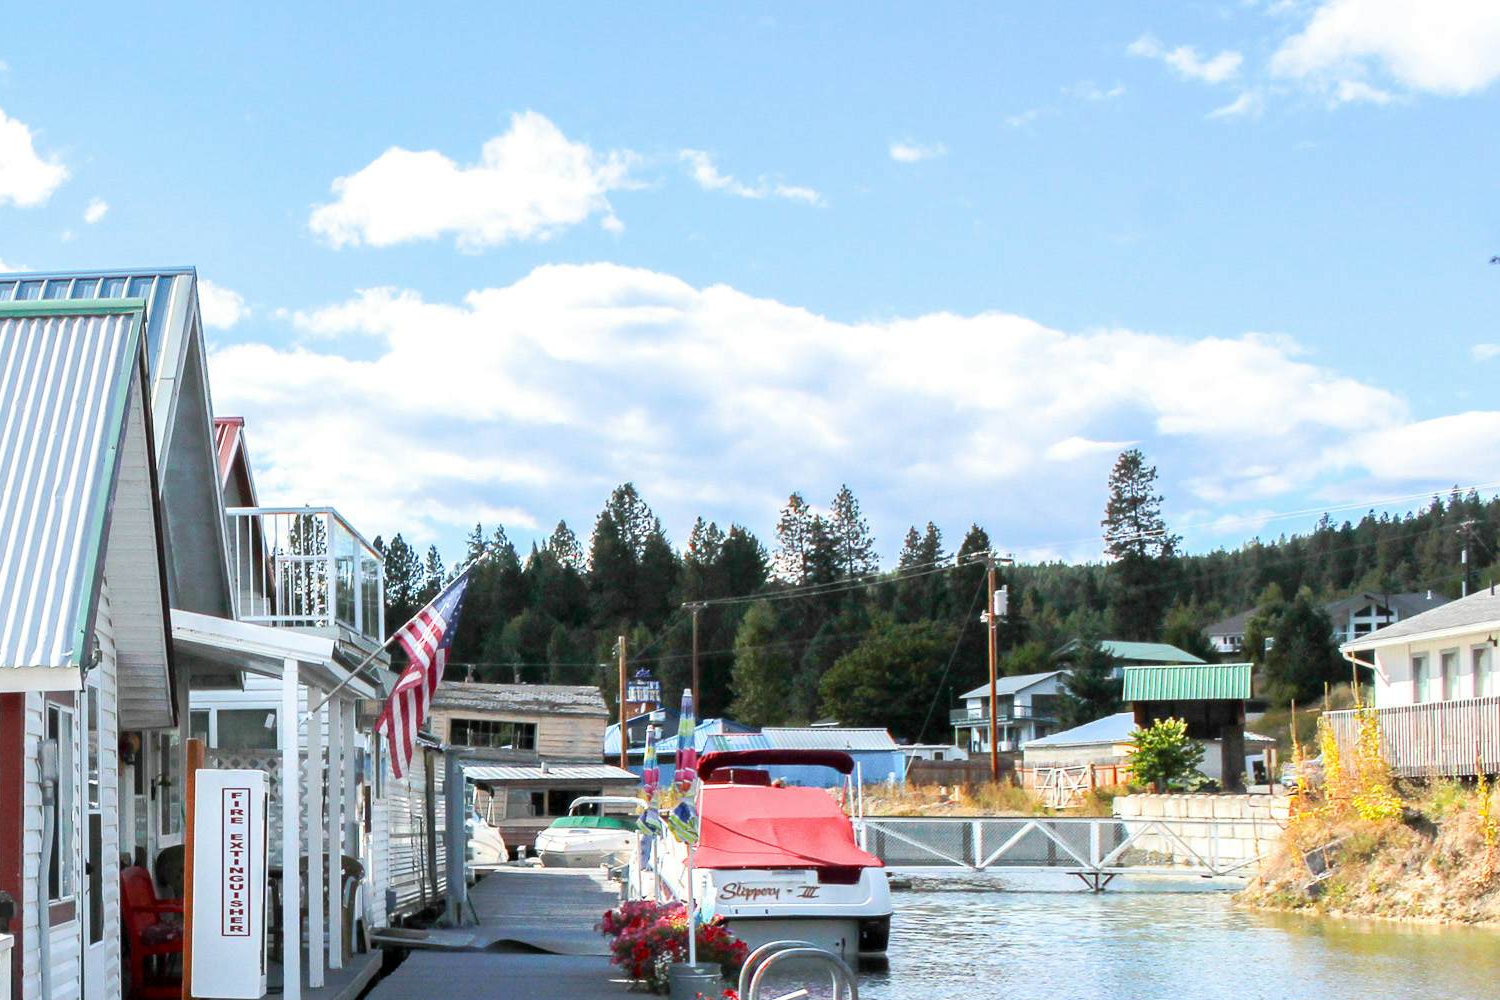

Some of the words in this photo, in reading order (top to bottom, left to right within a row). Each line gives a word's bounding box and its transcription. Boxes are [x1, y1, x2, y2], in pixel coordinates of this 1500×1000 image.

[230, 792, 244, 824] FIRE
[229, 833, 244, 932] EXTINGUISHER
[796, 886, 820, 898] III
